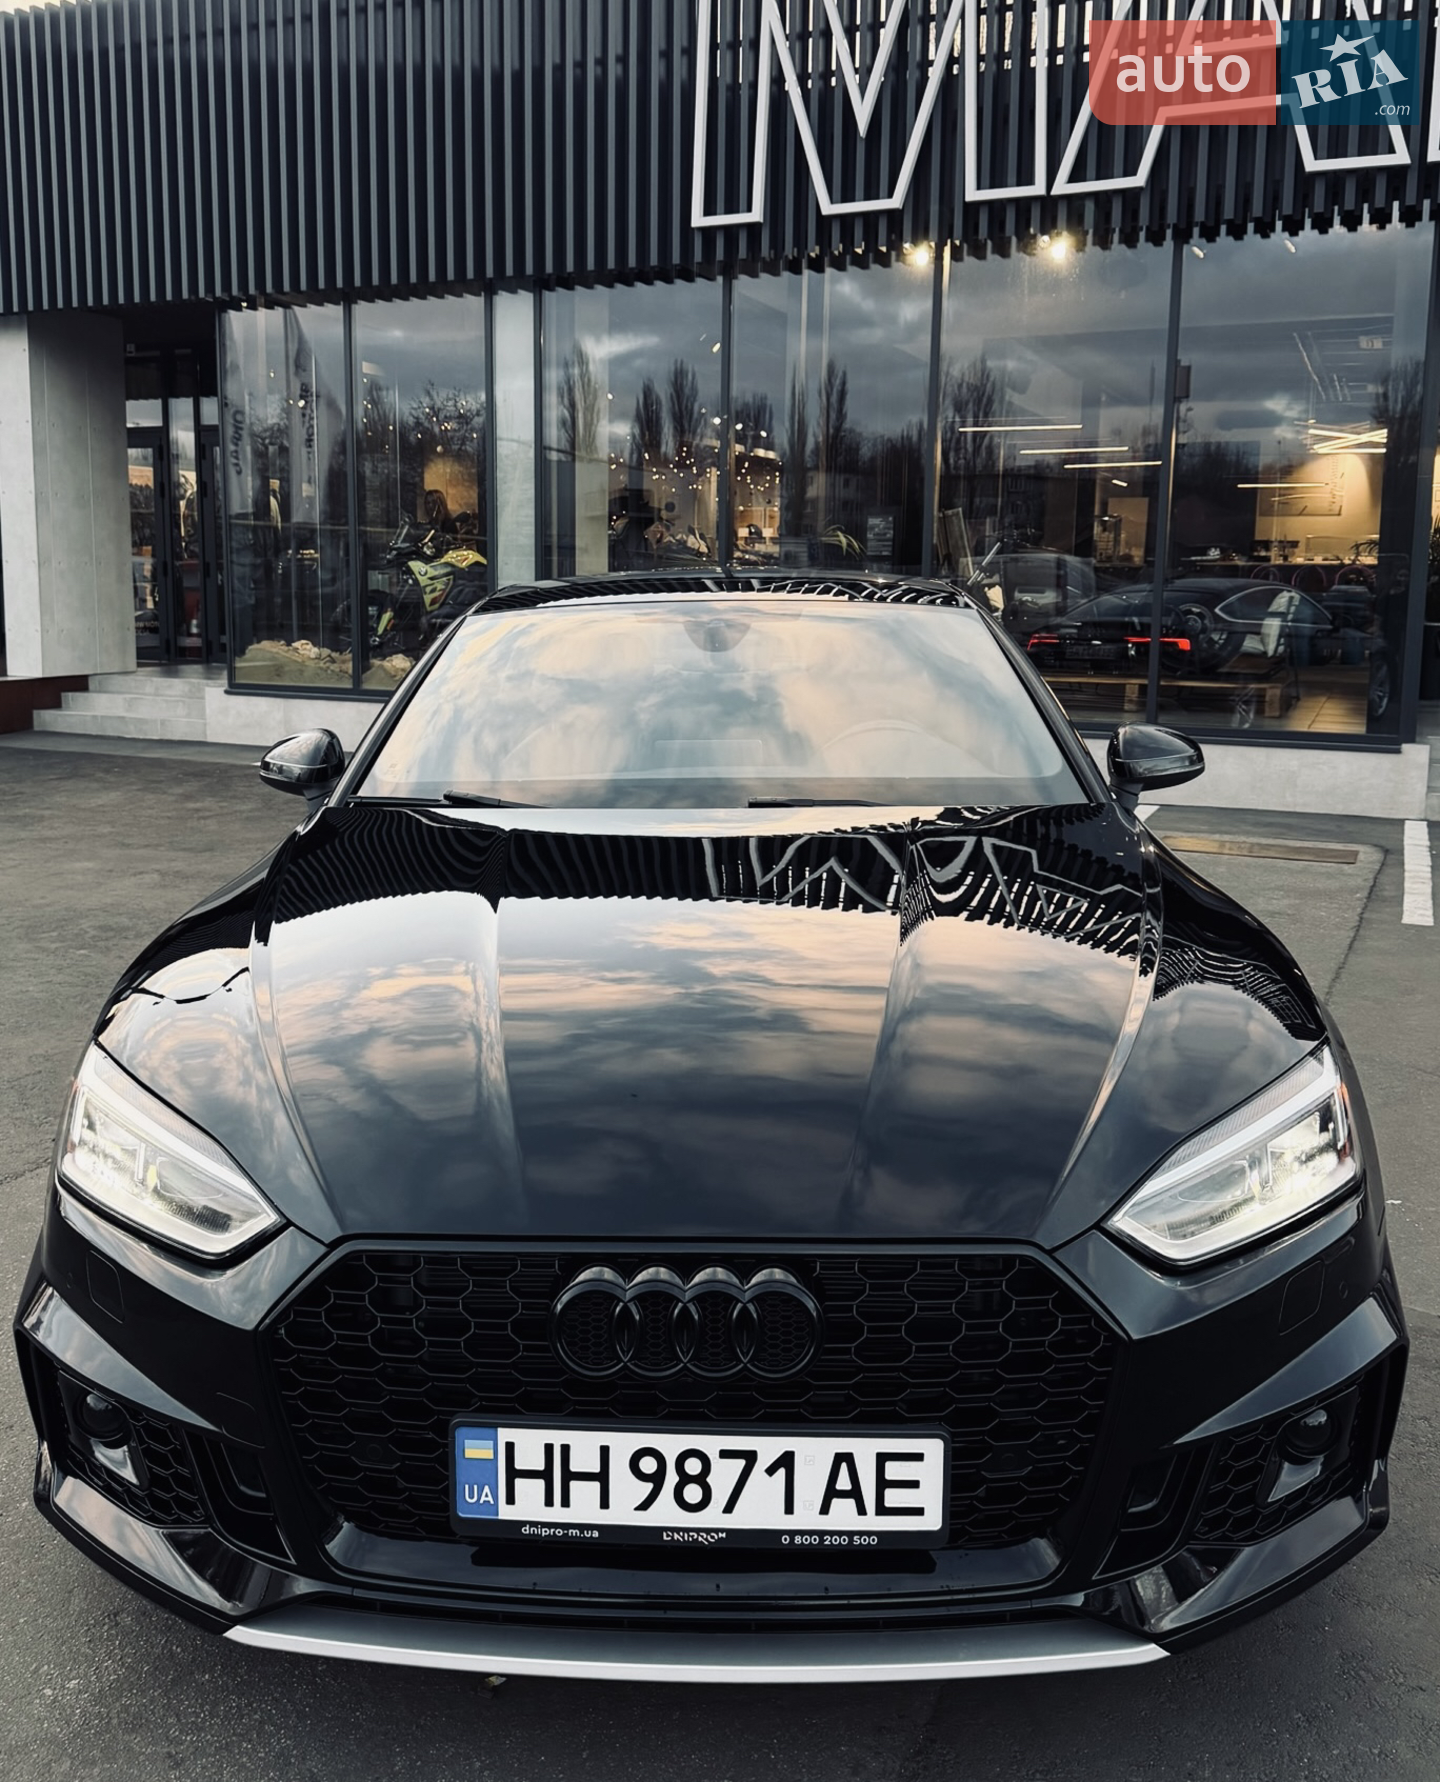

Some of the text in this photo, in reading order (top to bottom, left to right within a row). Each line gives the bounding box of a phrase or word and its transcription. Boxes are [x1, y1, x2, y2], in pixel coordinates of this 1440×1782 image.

[505, 1441, 925, 1517] HH 9871 AE
[464, 1484, 495, 1505] UA
[521, 1524, 599, 1538] dnipro-m.ua
[781, 1534, 878, 1546] 0 800 200 500
